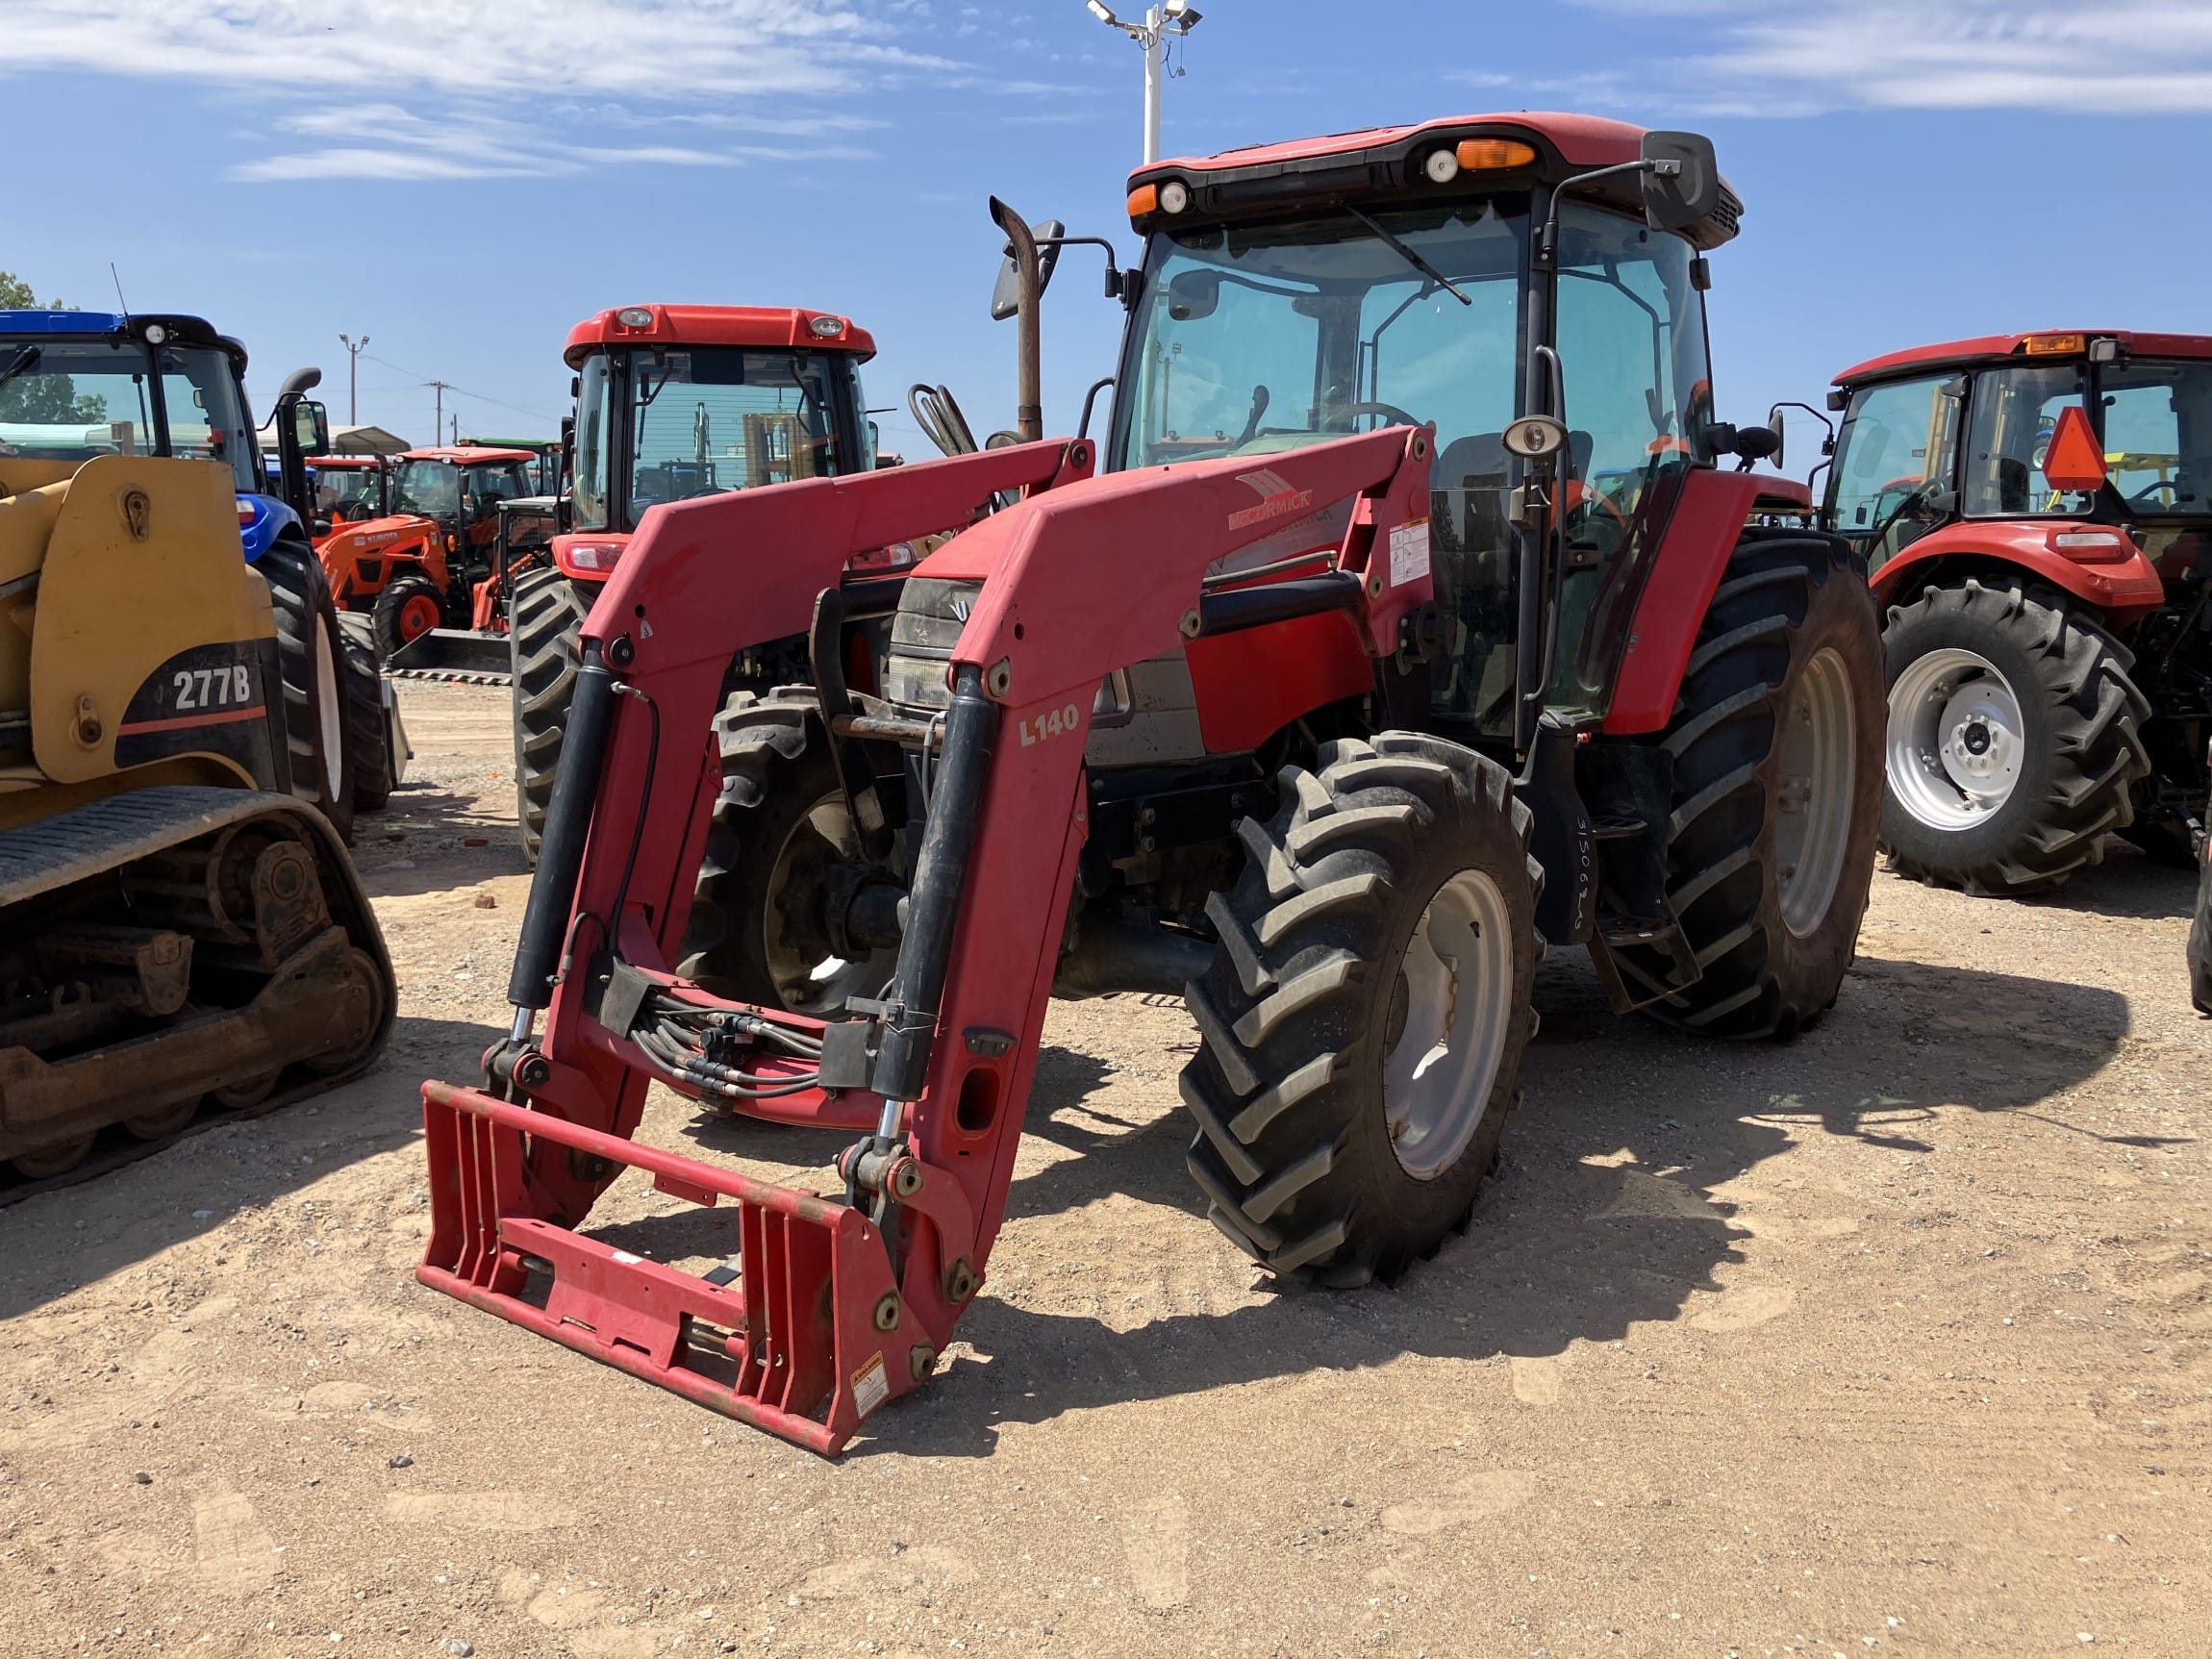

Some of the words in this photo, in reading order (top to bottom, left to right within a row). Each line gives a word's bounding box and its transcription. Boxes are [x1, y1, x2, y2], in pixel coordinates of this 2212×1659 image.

[367, 532, 399, 543] KUBOTA
[174, 666, 250, 710] 277B
[1019, 704, 1079, 747] L140
